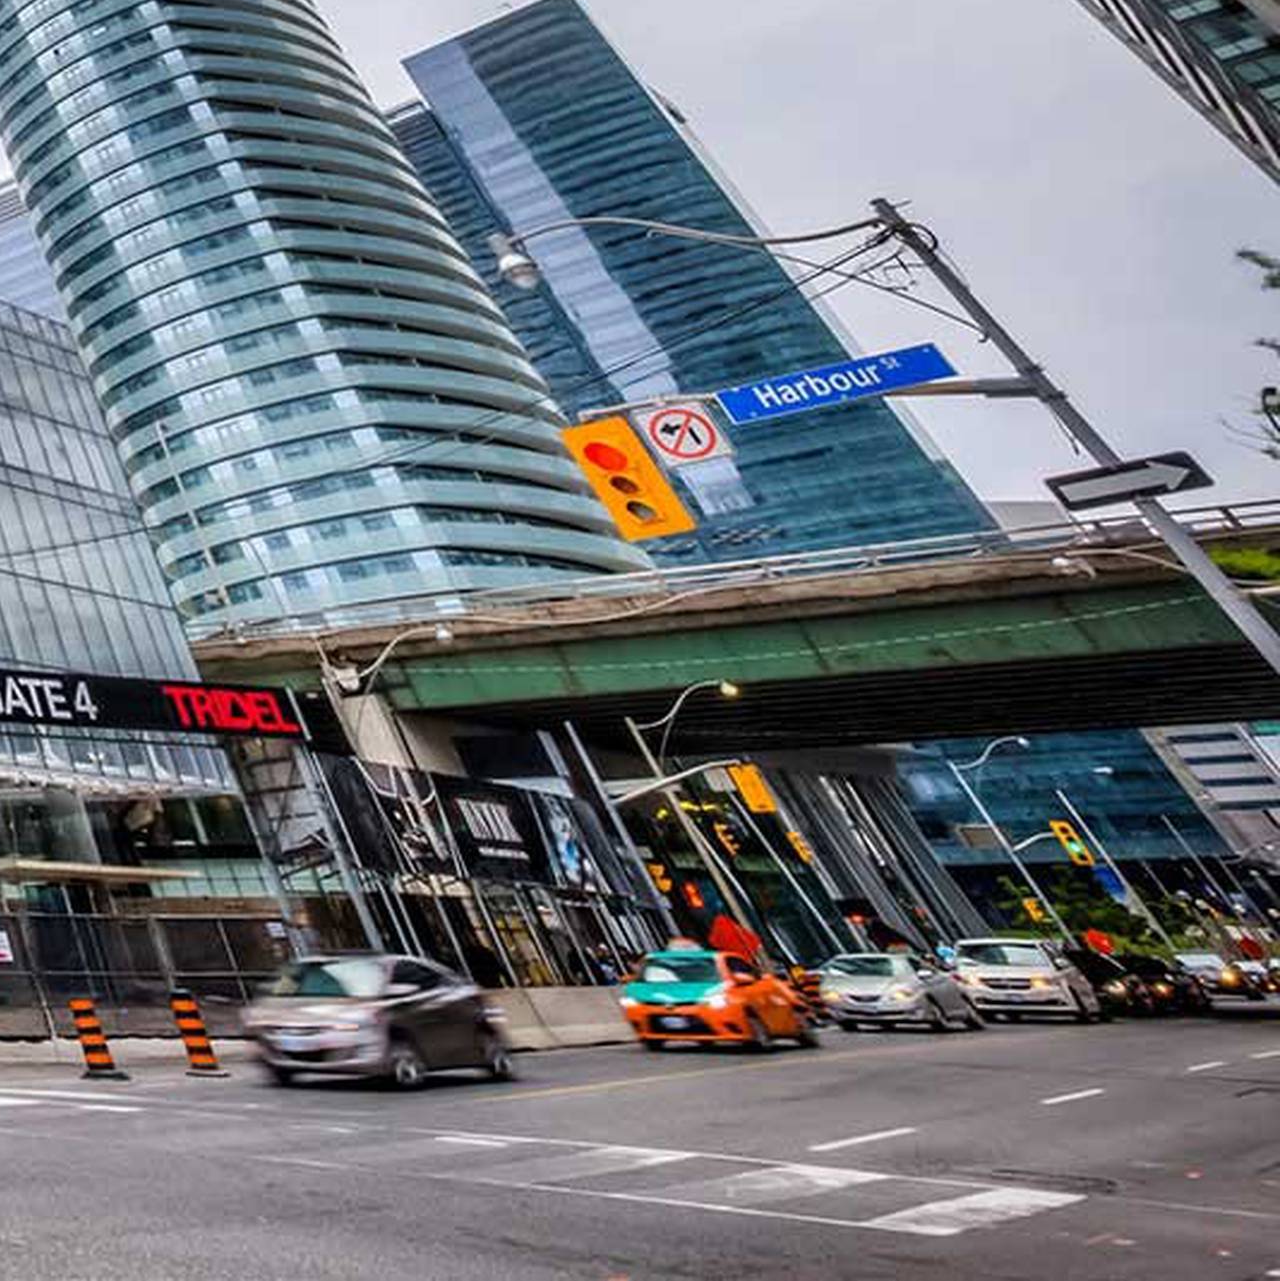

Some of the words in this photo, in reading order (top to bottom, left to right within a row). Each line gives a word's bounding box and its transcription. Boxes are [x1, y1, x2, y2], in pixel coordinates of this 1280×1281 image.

[752, 365, 883, 409] Harbour
[74, 680, 98, 721] 4
[162, 685, 300, 733] TRIDEL
